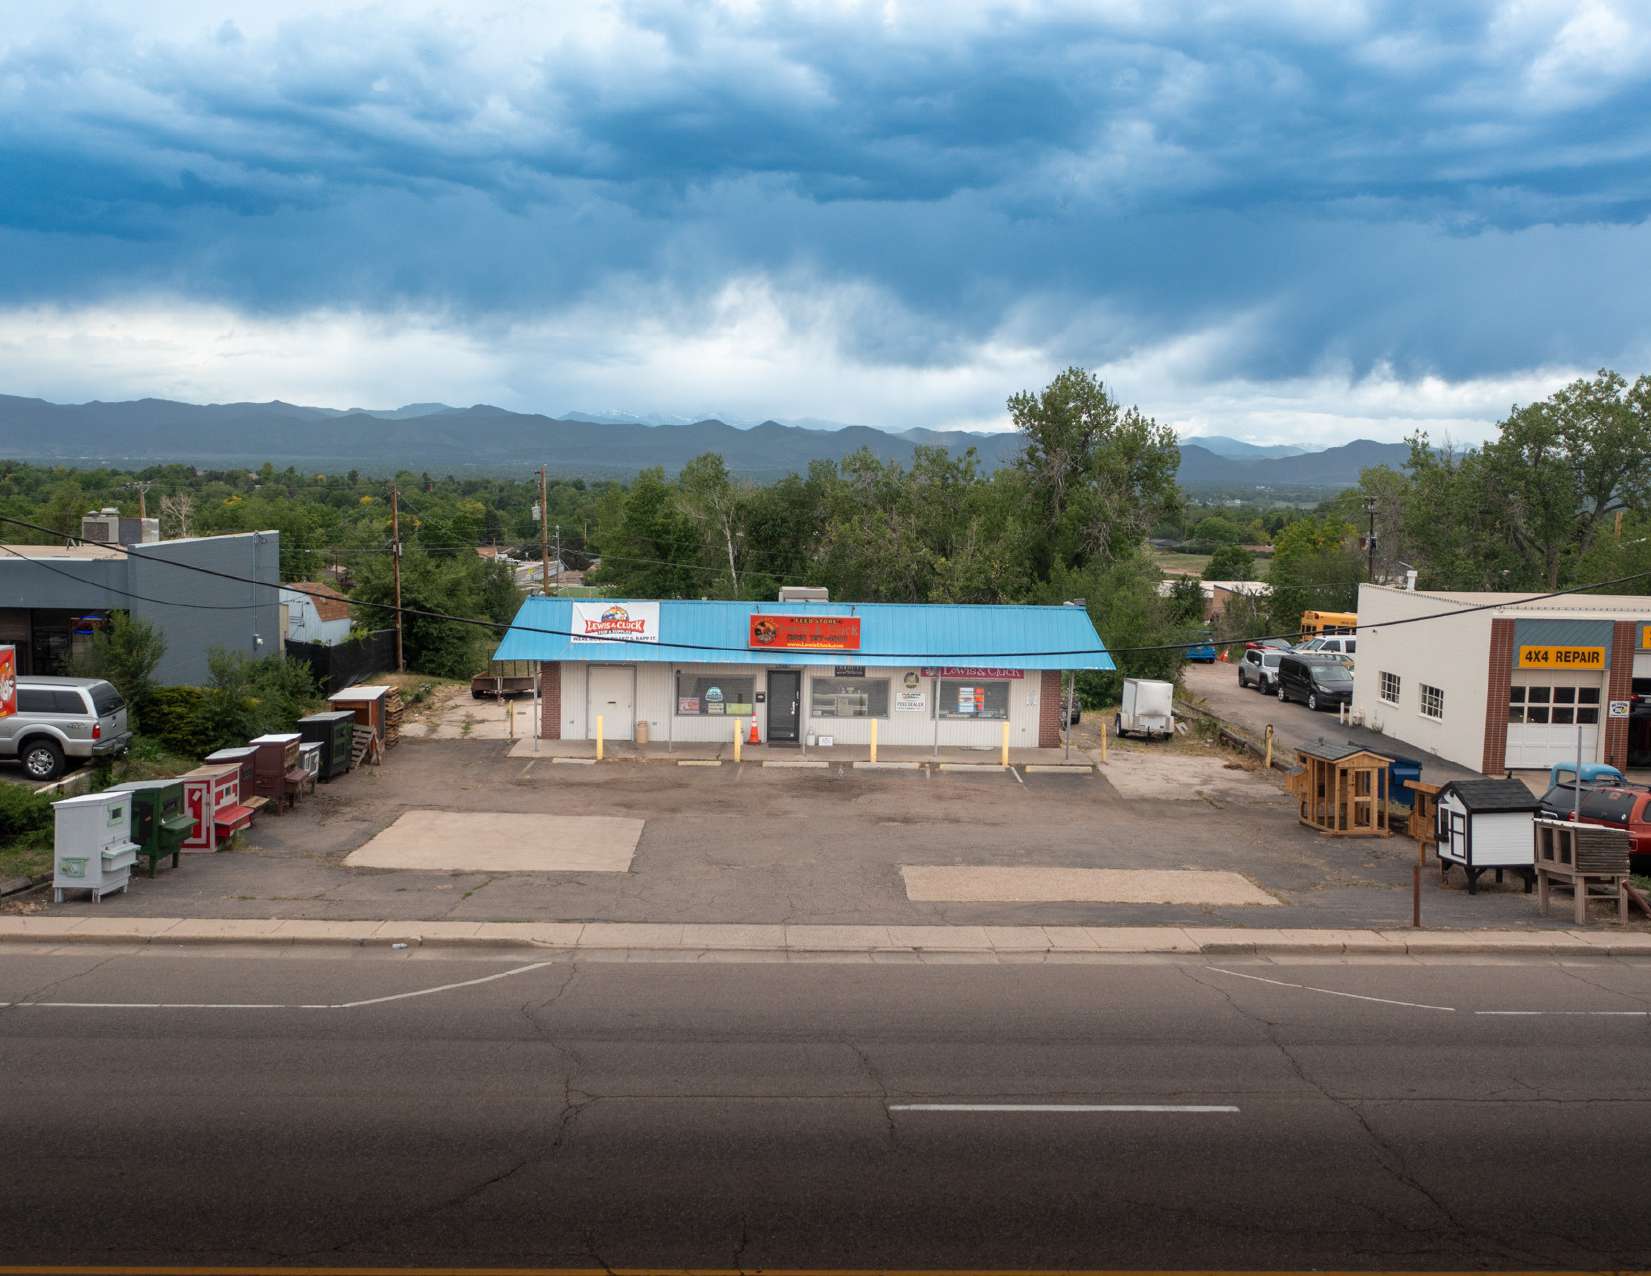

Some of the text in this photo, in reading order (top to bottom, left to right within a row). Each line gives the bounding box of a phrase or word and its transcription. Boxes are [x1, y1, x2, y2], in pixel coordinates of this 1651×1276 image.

[616, 620, 643, 631] CLUCK
[1525, 650, 1600, 664] 4X4 REPAIR
